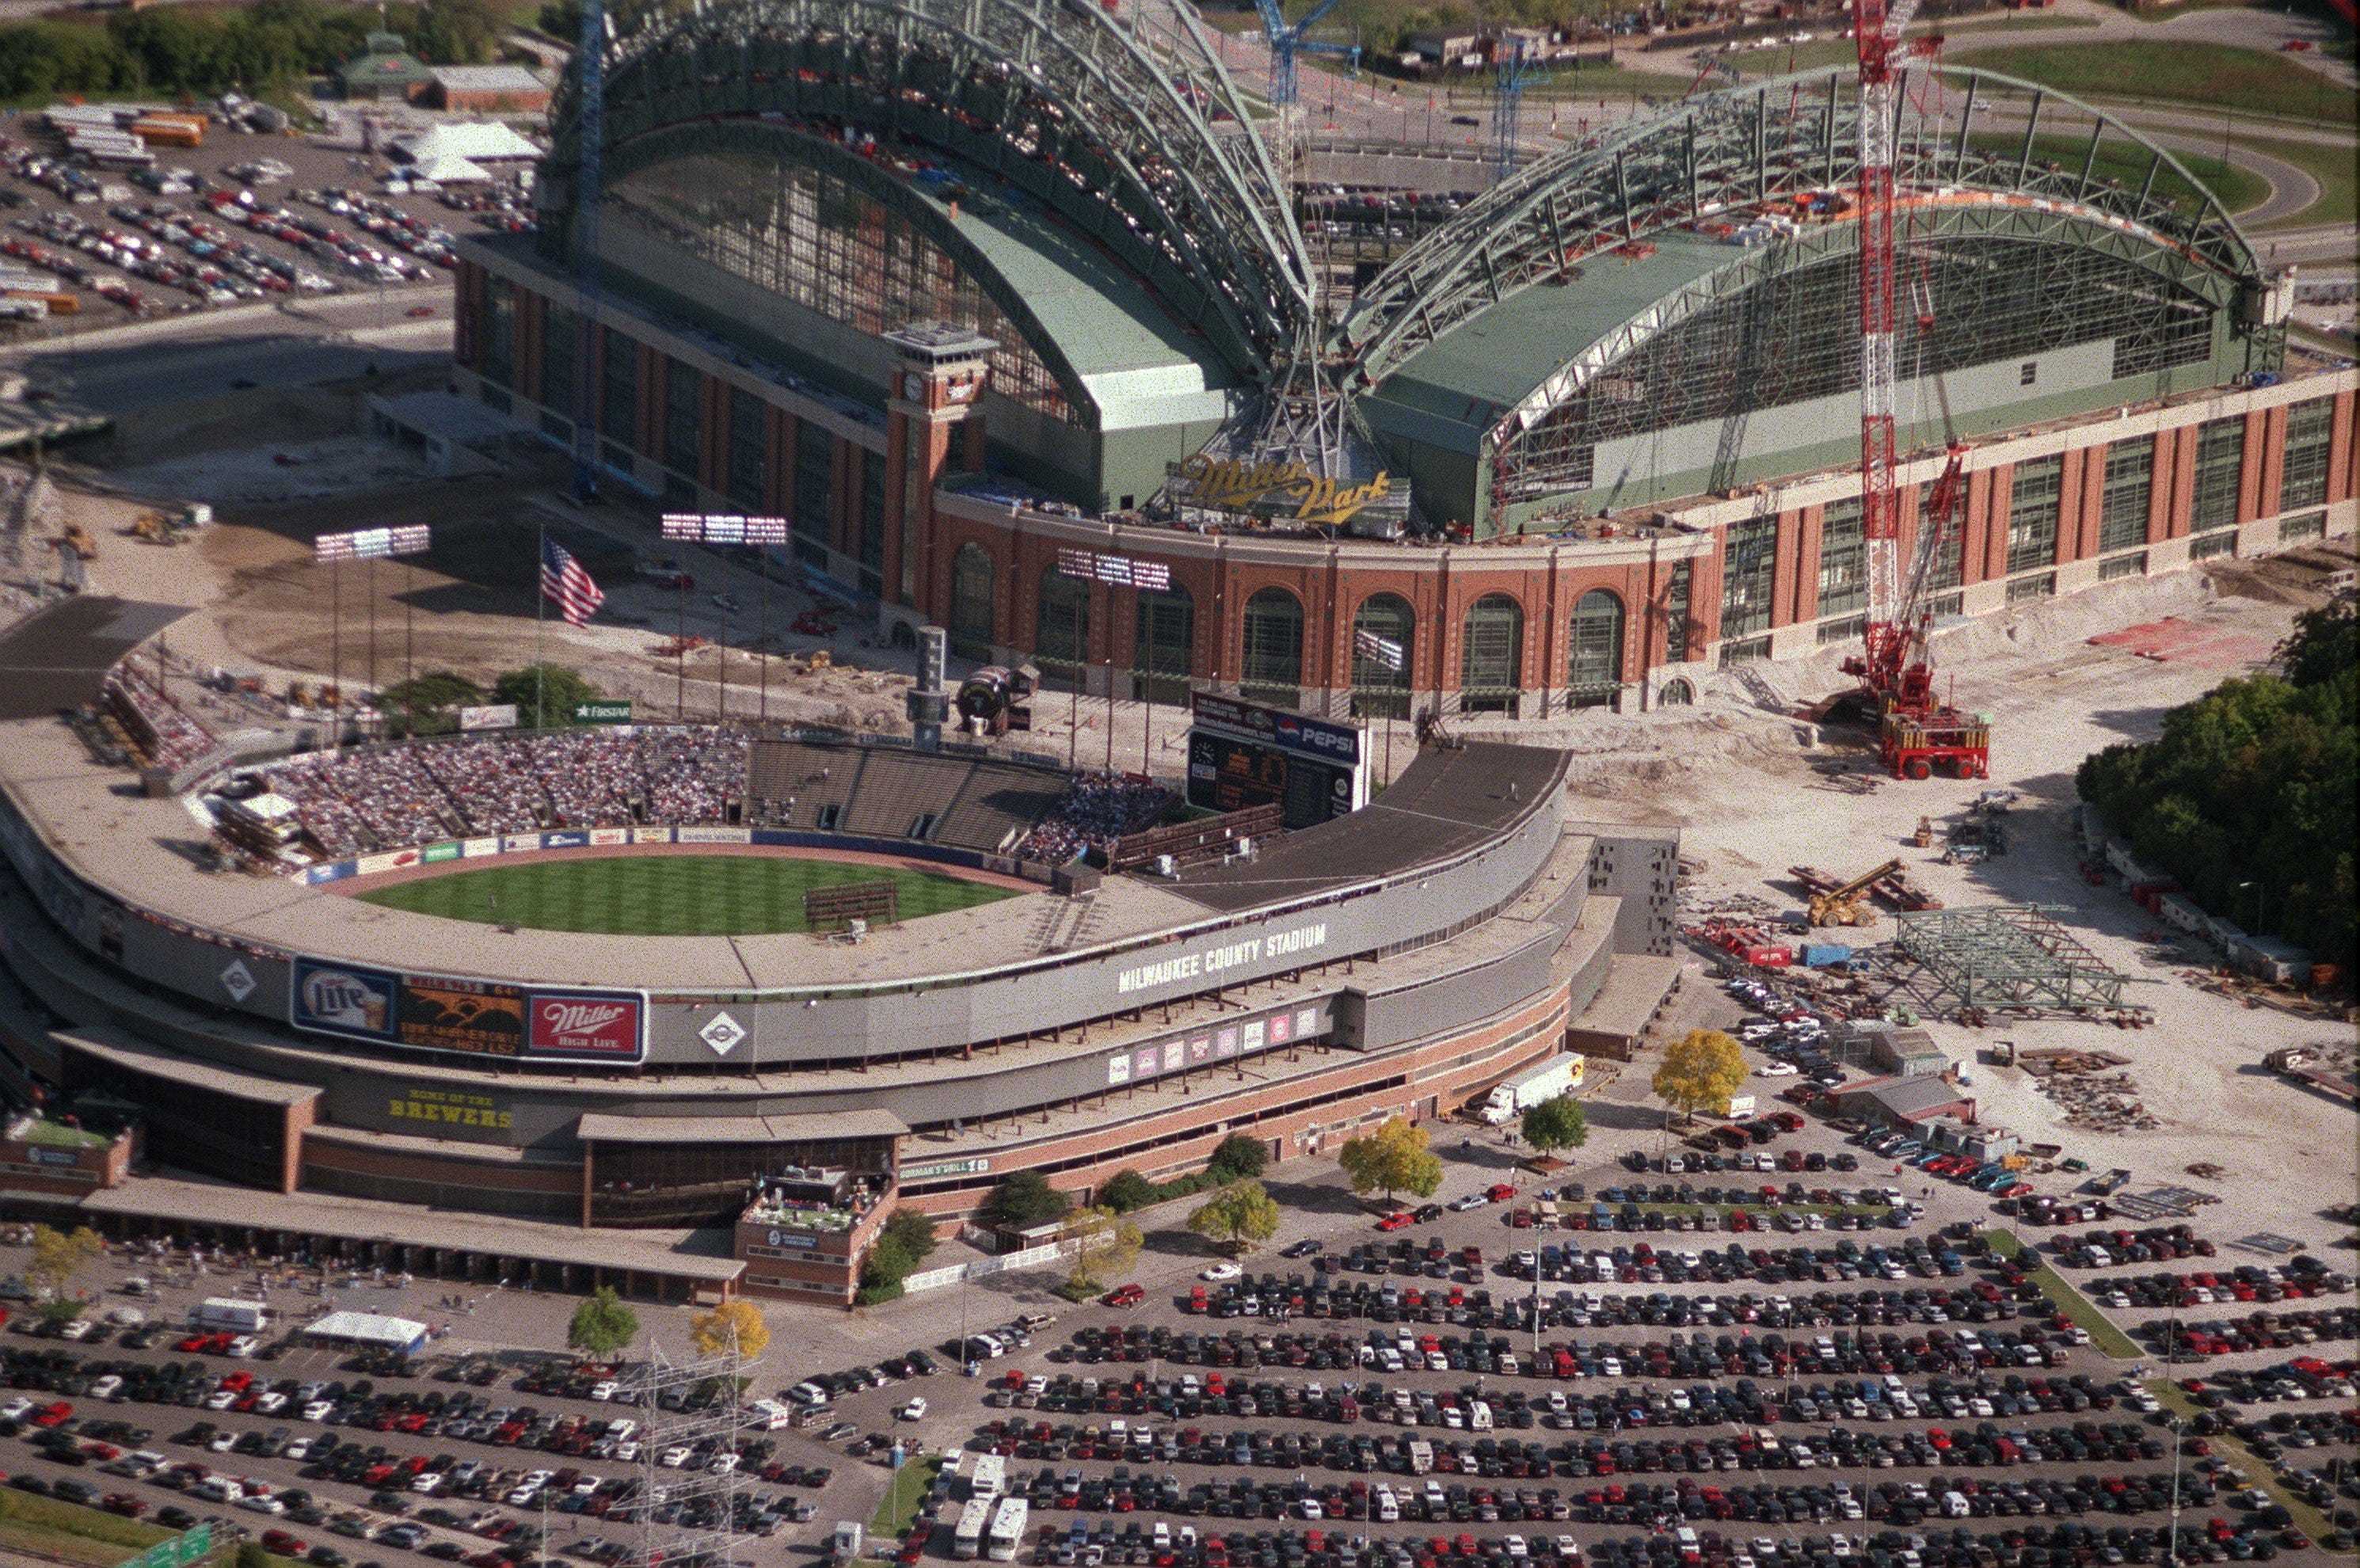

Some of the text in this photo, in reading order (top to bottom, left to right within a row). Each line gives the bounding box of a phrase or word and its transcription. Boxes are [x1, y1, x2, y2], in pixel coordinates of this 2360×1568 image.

[1181, 453, 1308, 502] Miller
[1286, 470, 1391, 520] Park
[1301, 727, 1354, 752] PEPSI
[1119, 923, 1327, 993] MILWAUKEE COUNTY STADIUM
[314, 981, 365, 1017] Lite
[543, 1003, 625, 1035] Miller
[558, 1036, 620, 1048] HIGH LIFE
[389, 1099, 512, 1128] BREWERS
[409, 1090, 493, 1106] HOME OF THE
